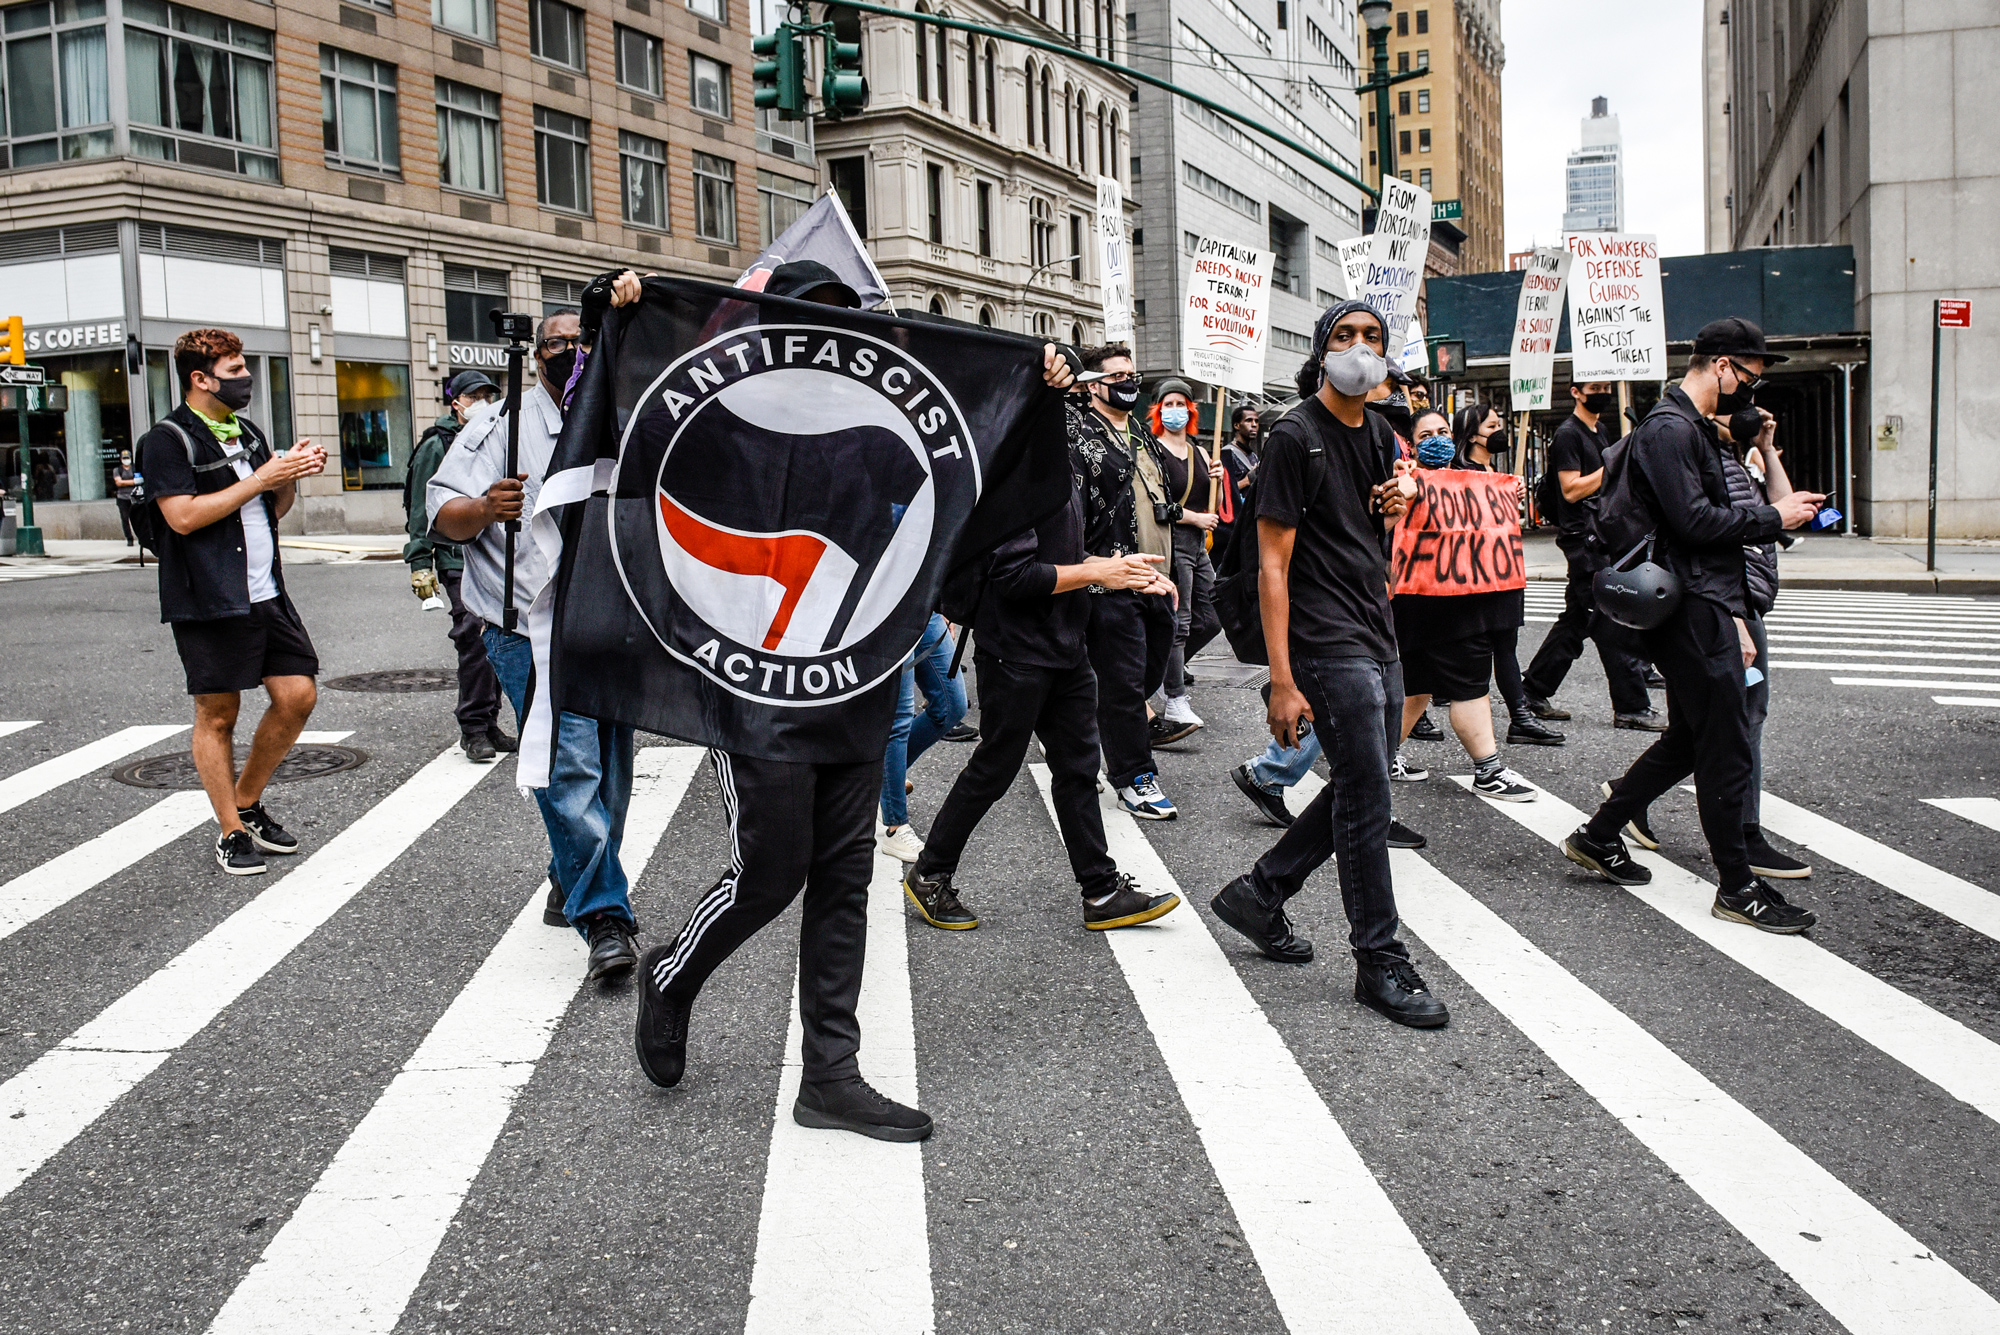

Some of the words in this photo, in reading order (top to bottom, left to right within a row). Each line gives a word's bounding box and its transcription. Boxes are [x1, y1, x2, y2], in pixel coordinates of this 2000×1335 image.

[1388, 184, 1416, 214] FROM
[1448, 202, 1458, 211] ST
[1378, 209, 1421, 241] PORTLAND
[1106, 240, 1122, 270] OUT
[1200, 237, 1257, 266] CAPITALISM
[1388, 240, 1410, 262] NYC
[1568, 236, 1596, 258] FOR
[1598, 236, 1657, 260] WORKERS
[1196, 260, 1232, 278] BREEDS
[1235, 268, 1263, 288] RACIST
[1366, 262, 1417, 291] DEMOCRATS
[1586, 260, 1644, 280] DEFENSE
[1207, 280, 1249, 302] TERROR!
[1364, 291, 1402, 312] PROTECT
[1590, 281, 1640, 304] GUARDS
[1190, 296, 1208, 310] FOR
[1216, 300, 1258, 321] SOCIALIST
[1577, 304, 1626, 327] AGAINST
[1629, 306, 1652, 322] THE
[45, 324, 122, 349] COFFEE
[1584, 330, 1635, 349] FASCIST
[450, 345, 510, 367] SOUND
[1190, 360, 1234, 374] INTERNATIONALIST
[1194, 350, 1232, 365] REVOLUTIONARY
[1611, 348, 1652, 364] THREAT
[5, 370, 18, 379] ONE
[26, 372, 40, 381] WAY
[1200, 369, 1216, 378] YOUTH
[1576, 368, 1626, 378] INTERNATIONALIST
[1632, 368, 1651, 376] GROUP
[662, 335, 962, 460] ANTIFASCIST
[1404, 475, 1482, 531] PROUD
[1404, 531, 1491, 584] FUCK
[1493, 534, 1523, 580] OF
[692, 638, 860, 695] ACTION
[1744, 900, 1768, 917] N
